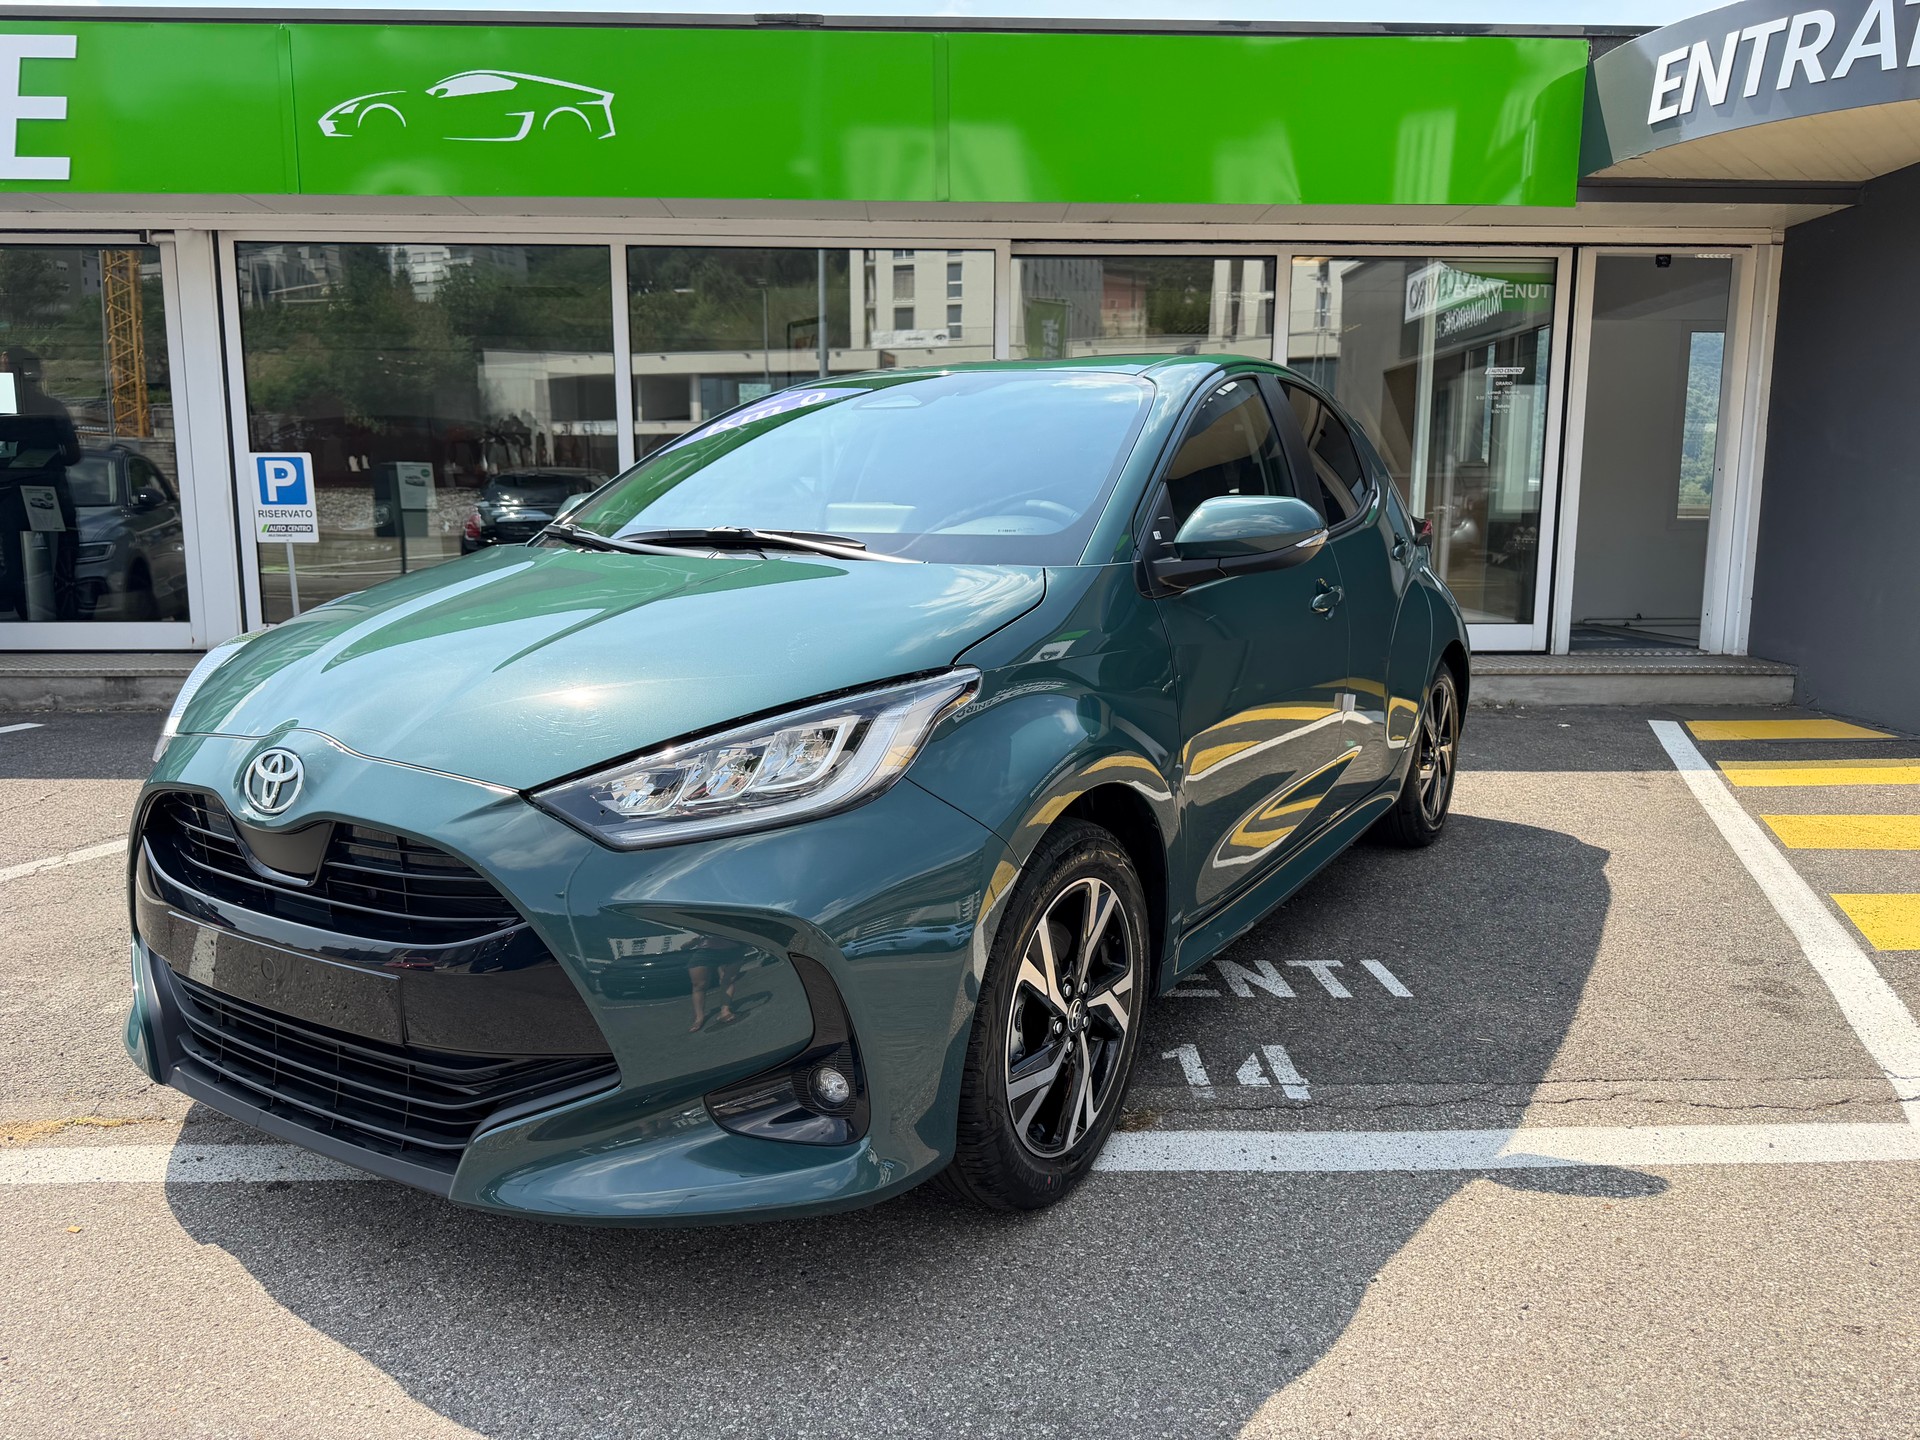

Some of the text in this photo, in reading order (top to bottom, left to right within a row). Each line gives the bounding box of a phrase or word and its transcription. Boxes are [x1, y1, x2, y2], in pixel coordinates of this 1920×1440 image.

[1648, 0, 1920, 125] ENTRA
[264, 460, 297, 502] P
[258, 509, 313, 518] RISERVATO
[1162, 1043, 1312, 1100] 14
